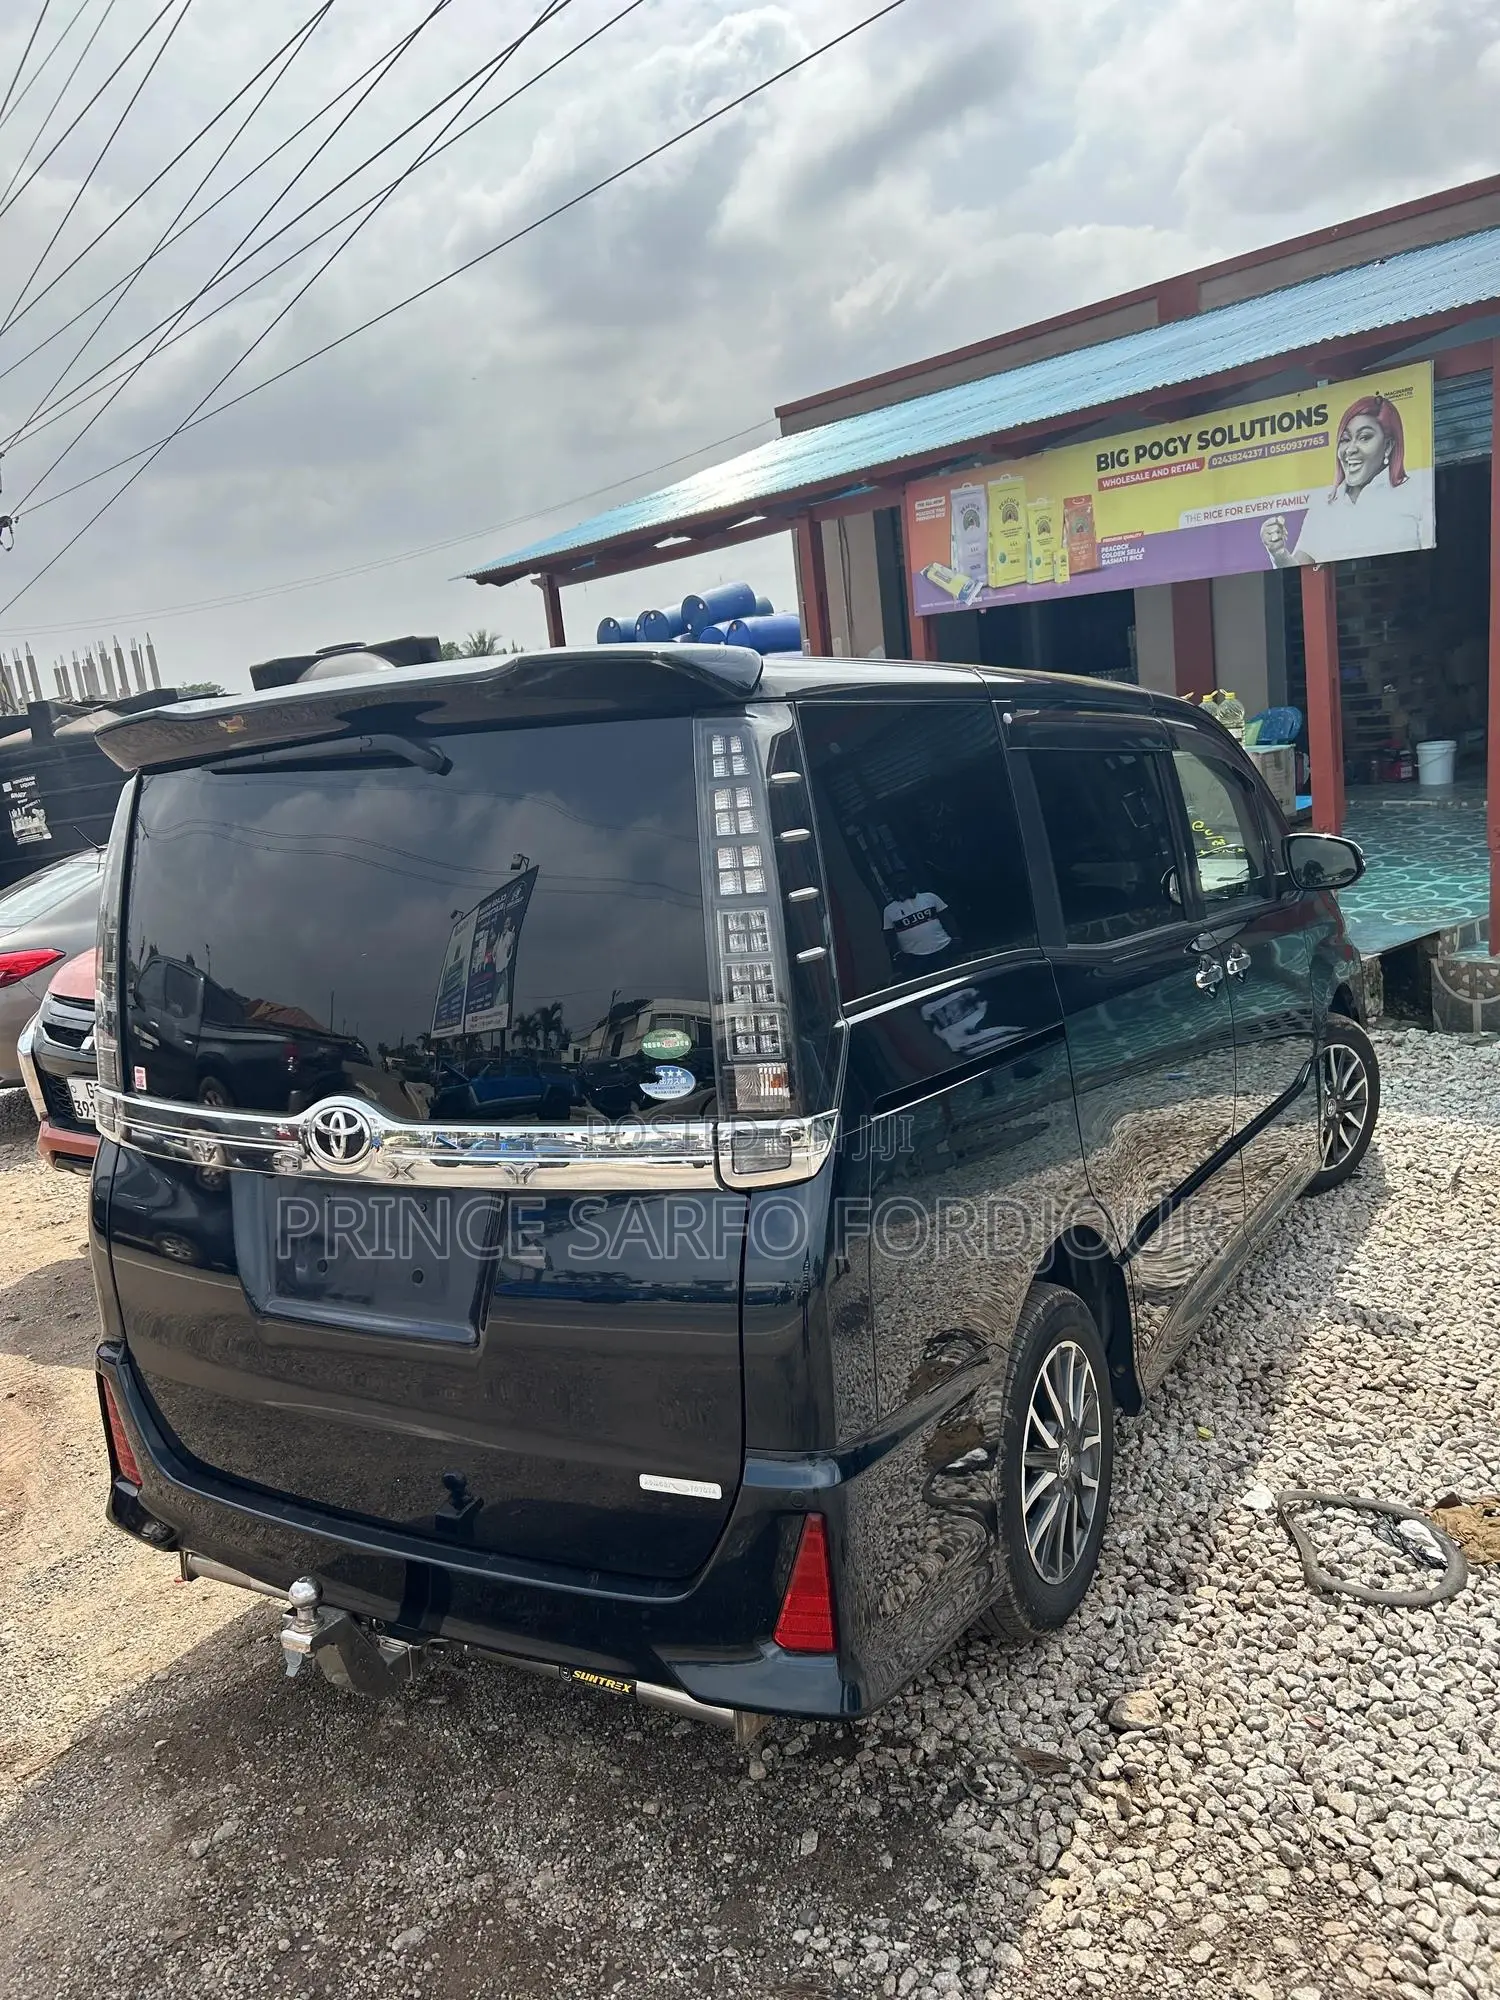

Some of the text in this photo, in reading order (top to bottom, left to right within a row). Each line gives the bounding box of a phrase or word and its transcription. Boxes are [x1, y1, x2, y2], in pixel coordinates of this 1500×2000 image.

[1096, 404, 1329, 472] BIG POGY SOLUTIONS
[1212, 447, 1263, 466] 0243824237
[1270, 435, 1325, 454] 0550937765
[1102, 462, 1200, 488] WHOLESALE AND RETAIL
[1185, 495, 1310, 523] THE RICE FOR EVERY FAMILY
[1101, 543, 1129, 553] PEACOCK
[1101, 553, 1144, 566] BASMATI RICE
[1127, 547, 1145, 556] SELLA
[572, 1670, 632, 1693] SUNTREX
